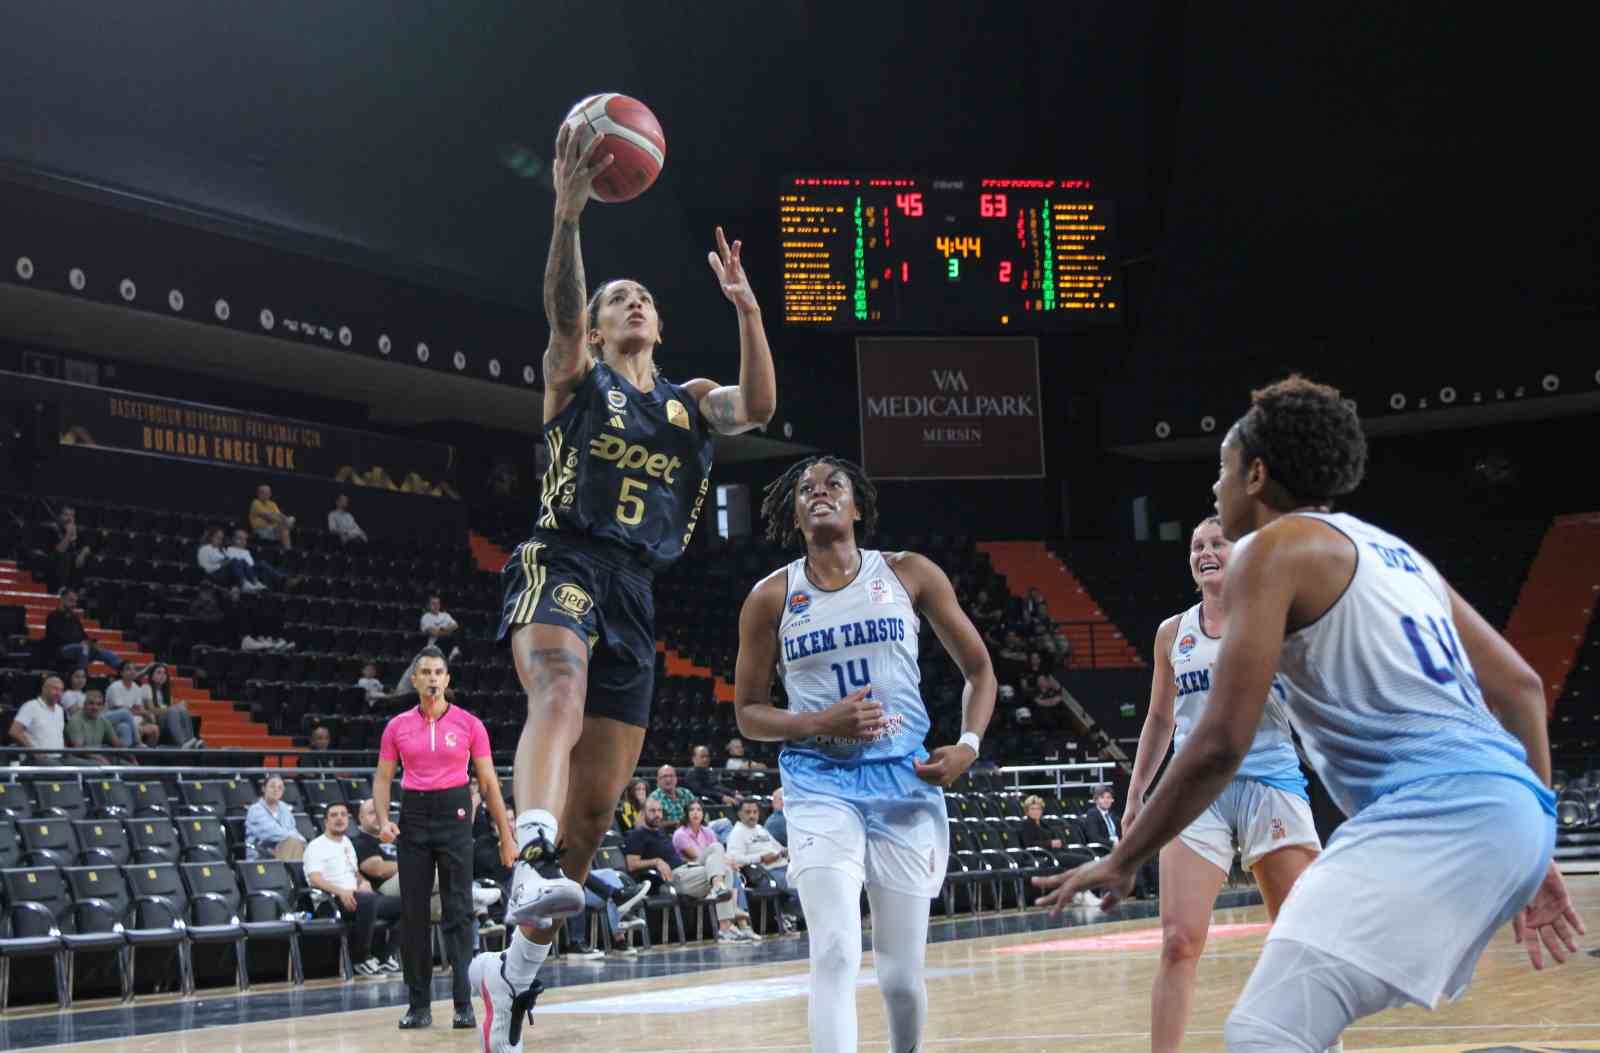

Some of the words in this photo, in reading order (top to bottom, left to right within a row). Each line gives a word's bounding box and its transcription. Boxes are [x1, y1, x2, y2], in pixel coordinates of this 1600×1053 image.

[896, 193, 923, 217] 45
[980, 194, 1007, 217] 63
[936, 236, 981, 258] 4:44
[948, 258, 959, 278] 3
[999, 261, 1011, 283] 2
[931, 369, 969, 392] VM
[866, 395, 1034, 418] MEDICALPARK
[615, 476, 649, 526] 5
[840, 617, 905, 648] TARSUS
[831, 657, 873, 699] 14
[1175, 668, 1210, 697] LKEM
